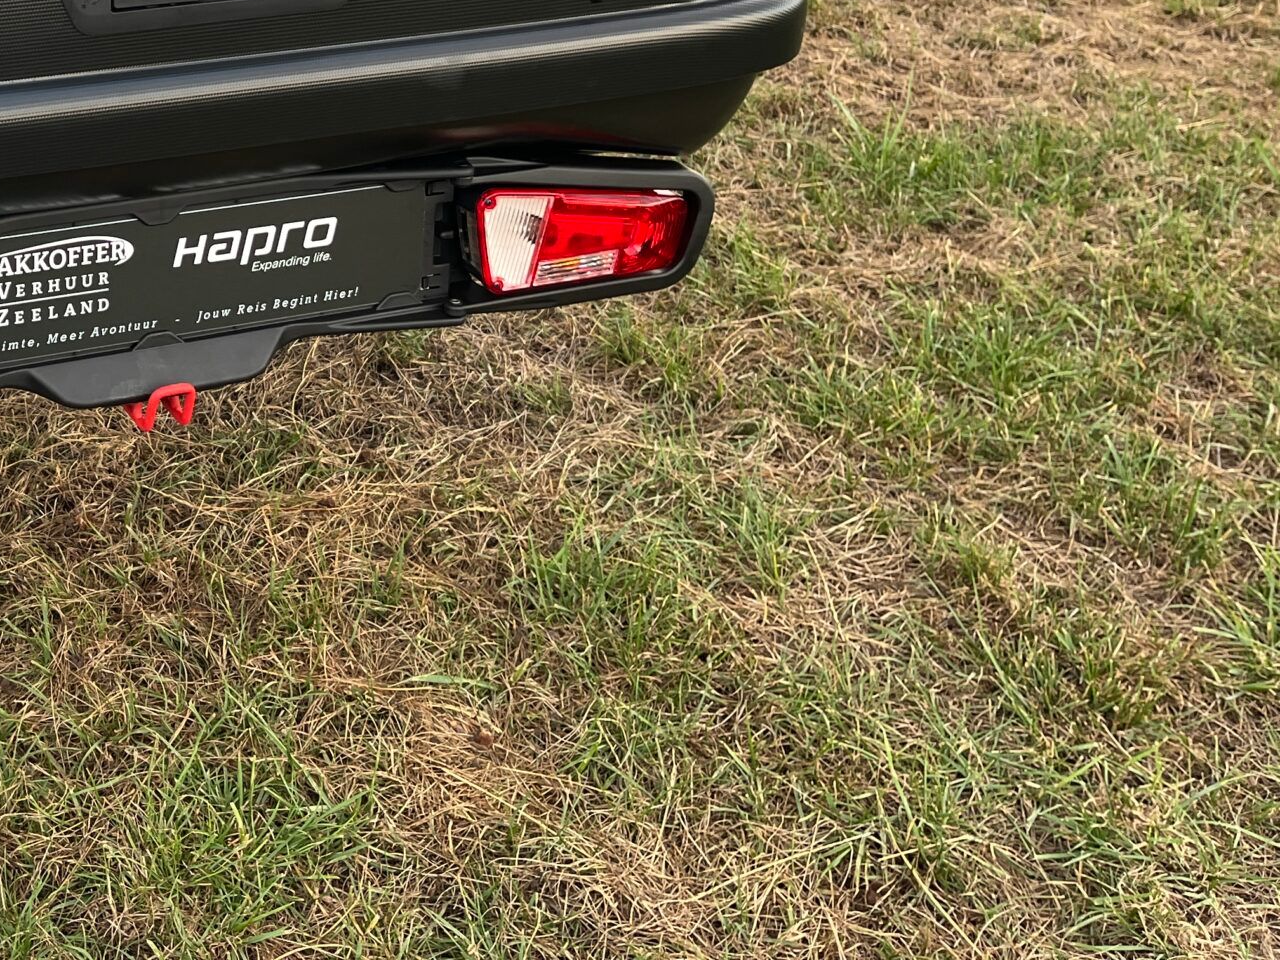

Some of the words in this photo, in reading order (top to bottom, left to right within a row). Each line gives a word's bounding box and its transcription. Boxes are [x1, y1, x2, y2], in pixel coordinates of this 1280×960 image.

[251, 254, 310, 272] Expanding
[312, 252, 332, 263] life.
[46, 330, 85, 345] Meer
[90, 319, 158, 338] Avontuur
[195, 307, 231, 324] Jouw
[237, 302, 267, 315] Reis
[273, 293, 318, 310] Begint
[323, 286, 360, 302] Hier!
